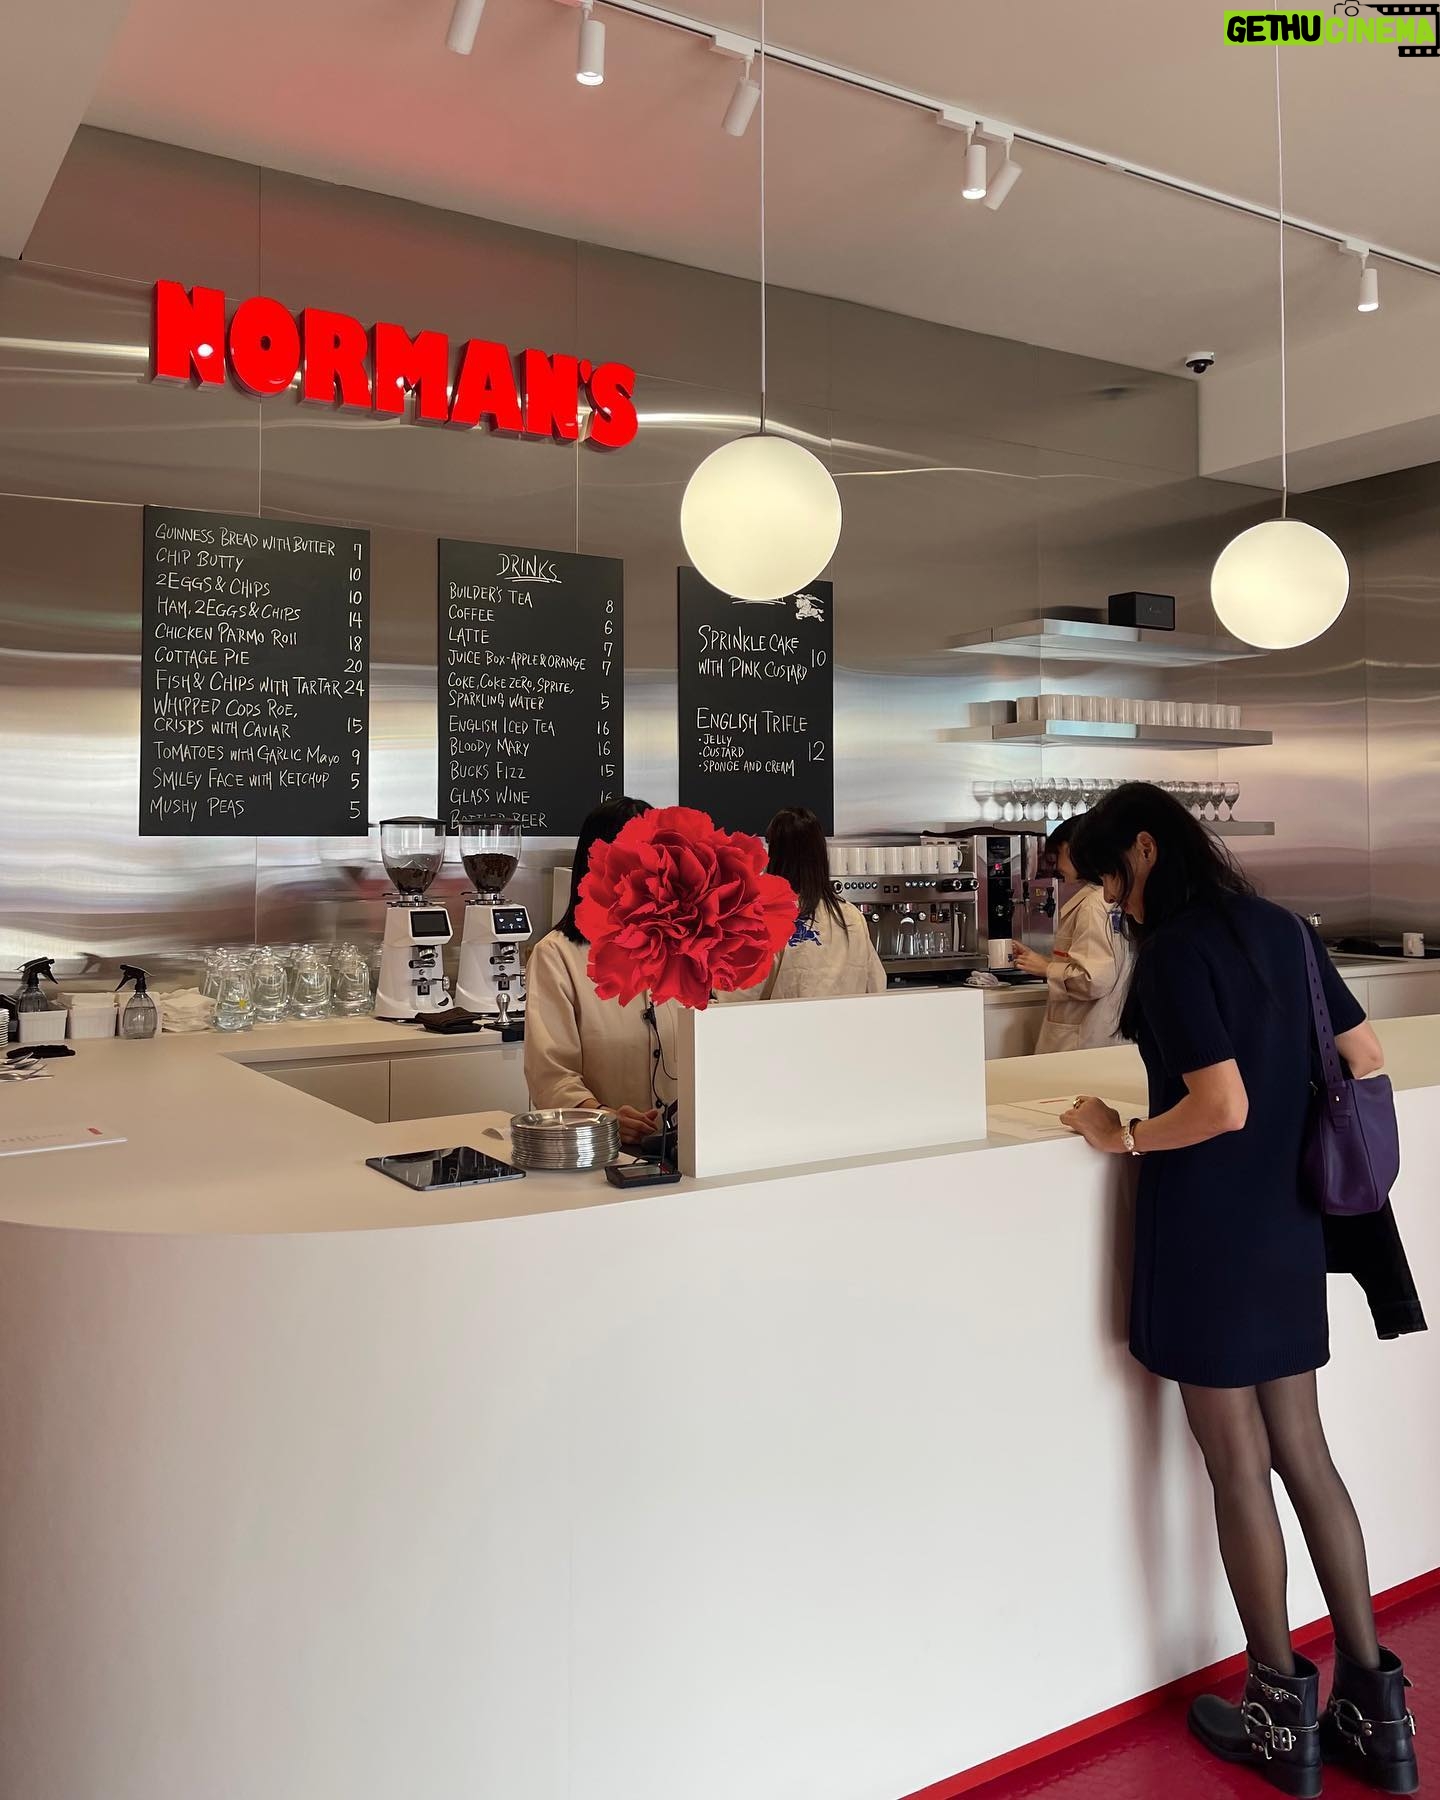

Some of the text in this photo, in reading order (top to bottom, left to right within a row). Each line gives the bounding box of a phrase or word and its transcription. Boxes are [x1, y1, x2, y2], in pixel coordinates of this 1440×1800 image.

[152, 279, 639, 449] NORMAN'S
[155, 522, 362, 561] GUINNESS BREAD WITH BUTTER 7
[155, 547, 362, 582] CHIP BUTTY 10
[496, 553, 560, 583] DRINKS
[229, 577, 271, 599] CHIPS
[349, 590, 363, 605] 10
[449, 581, 614, 614] BUILDER'S TEA 8
[157, 595, 192, 620] HAM,
[349, 611, 363, 629] 14
[448, 603, 613, 635] COFFEE 6
[154, 622, 213, 641] CHICKEN
[217, 621, 265, 646] PARMO
[349, 635, 363, 653] 18
[448, 626, 613, 658] LATTE 7
[698, 624, 800, 656] SPRINKLE CAKE
[154, 646, 363, 674] COTTAGE PIE 20
[447, 648, 481, 666] JUICE
[602, 660, 612, 676] 7
[698, 656, 808, 685] WITH PINK CUSTARD
[811, 649, 827, 668] 10
[156, 669, 191, 694] FISH
[209, 670, 255, 692] CHIPS
[259, 676, 289, 697] WITH
[292, 676, 343, 699] TARTAR
[343, 679, 365, 697] 24
[536, 677, 574, 695] SPRITE,
[153, 691, 221, 717] WHIPPED
[266, 698, 298, 719] ROE,
[448, 689, 610, 711] SPARKLING WATER 5
[153, 716, 363, 742] CRISPS WITH CAVIAR 15
[449, 715, 610, 737] ENGLISH ICED TEA 16
[696, 707, 808, 736] ENGLISH TRIFLE
[153, 740, 224, 763] TOMATOES
[230, 746, 254, 763] WITH
[256, 744, 302, 766] GARLIC
[351, 748, 361, 766] 9
[449, 736, 611, 758] BLOODY MARY 16
[808, 740, 825, 762] 12
[152, 766, 361, 791] SMILEY FACE WITH KETCHUP 5
[449, 760, 615, 781] BUCKS FIZZ 15
[743, 760, 762, 773] AND
[765, 759, 795, 777] CREAM
[150, 795, 361, 822] MUSHY PEAS 5
[449, 787, 490, 806] GLASS
[496, 785, 530, 804] WINE
